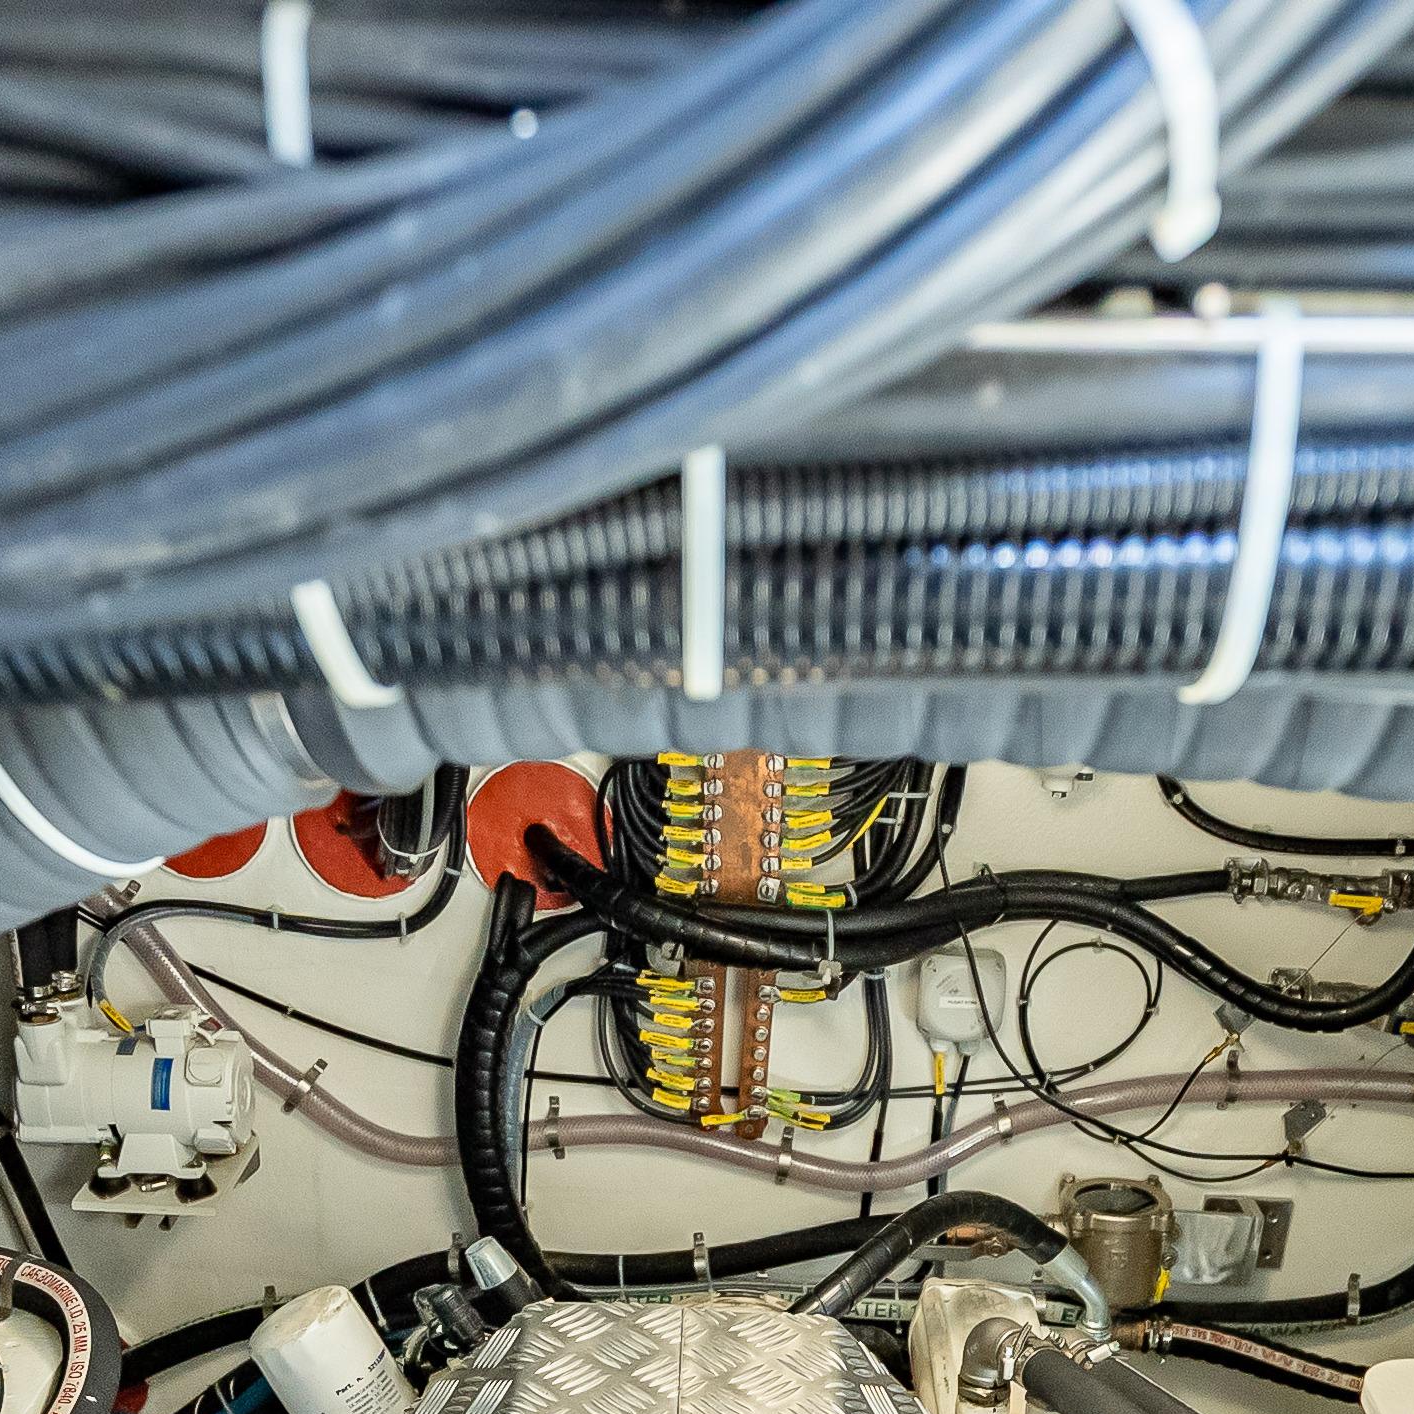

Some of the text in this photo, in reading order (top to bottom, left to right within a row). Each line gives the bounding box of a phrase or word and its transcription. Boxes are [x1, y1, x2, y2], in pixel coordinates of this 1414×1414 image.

[851, 1301, 902, 1318] ATER
[73, 1321, 86, 1334] 25
[69, 1361, 85, 1378] ISO
[58, 1380, 79, 1406] 7840
